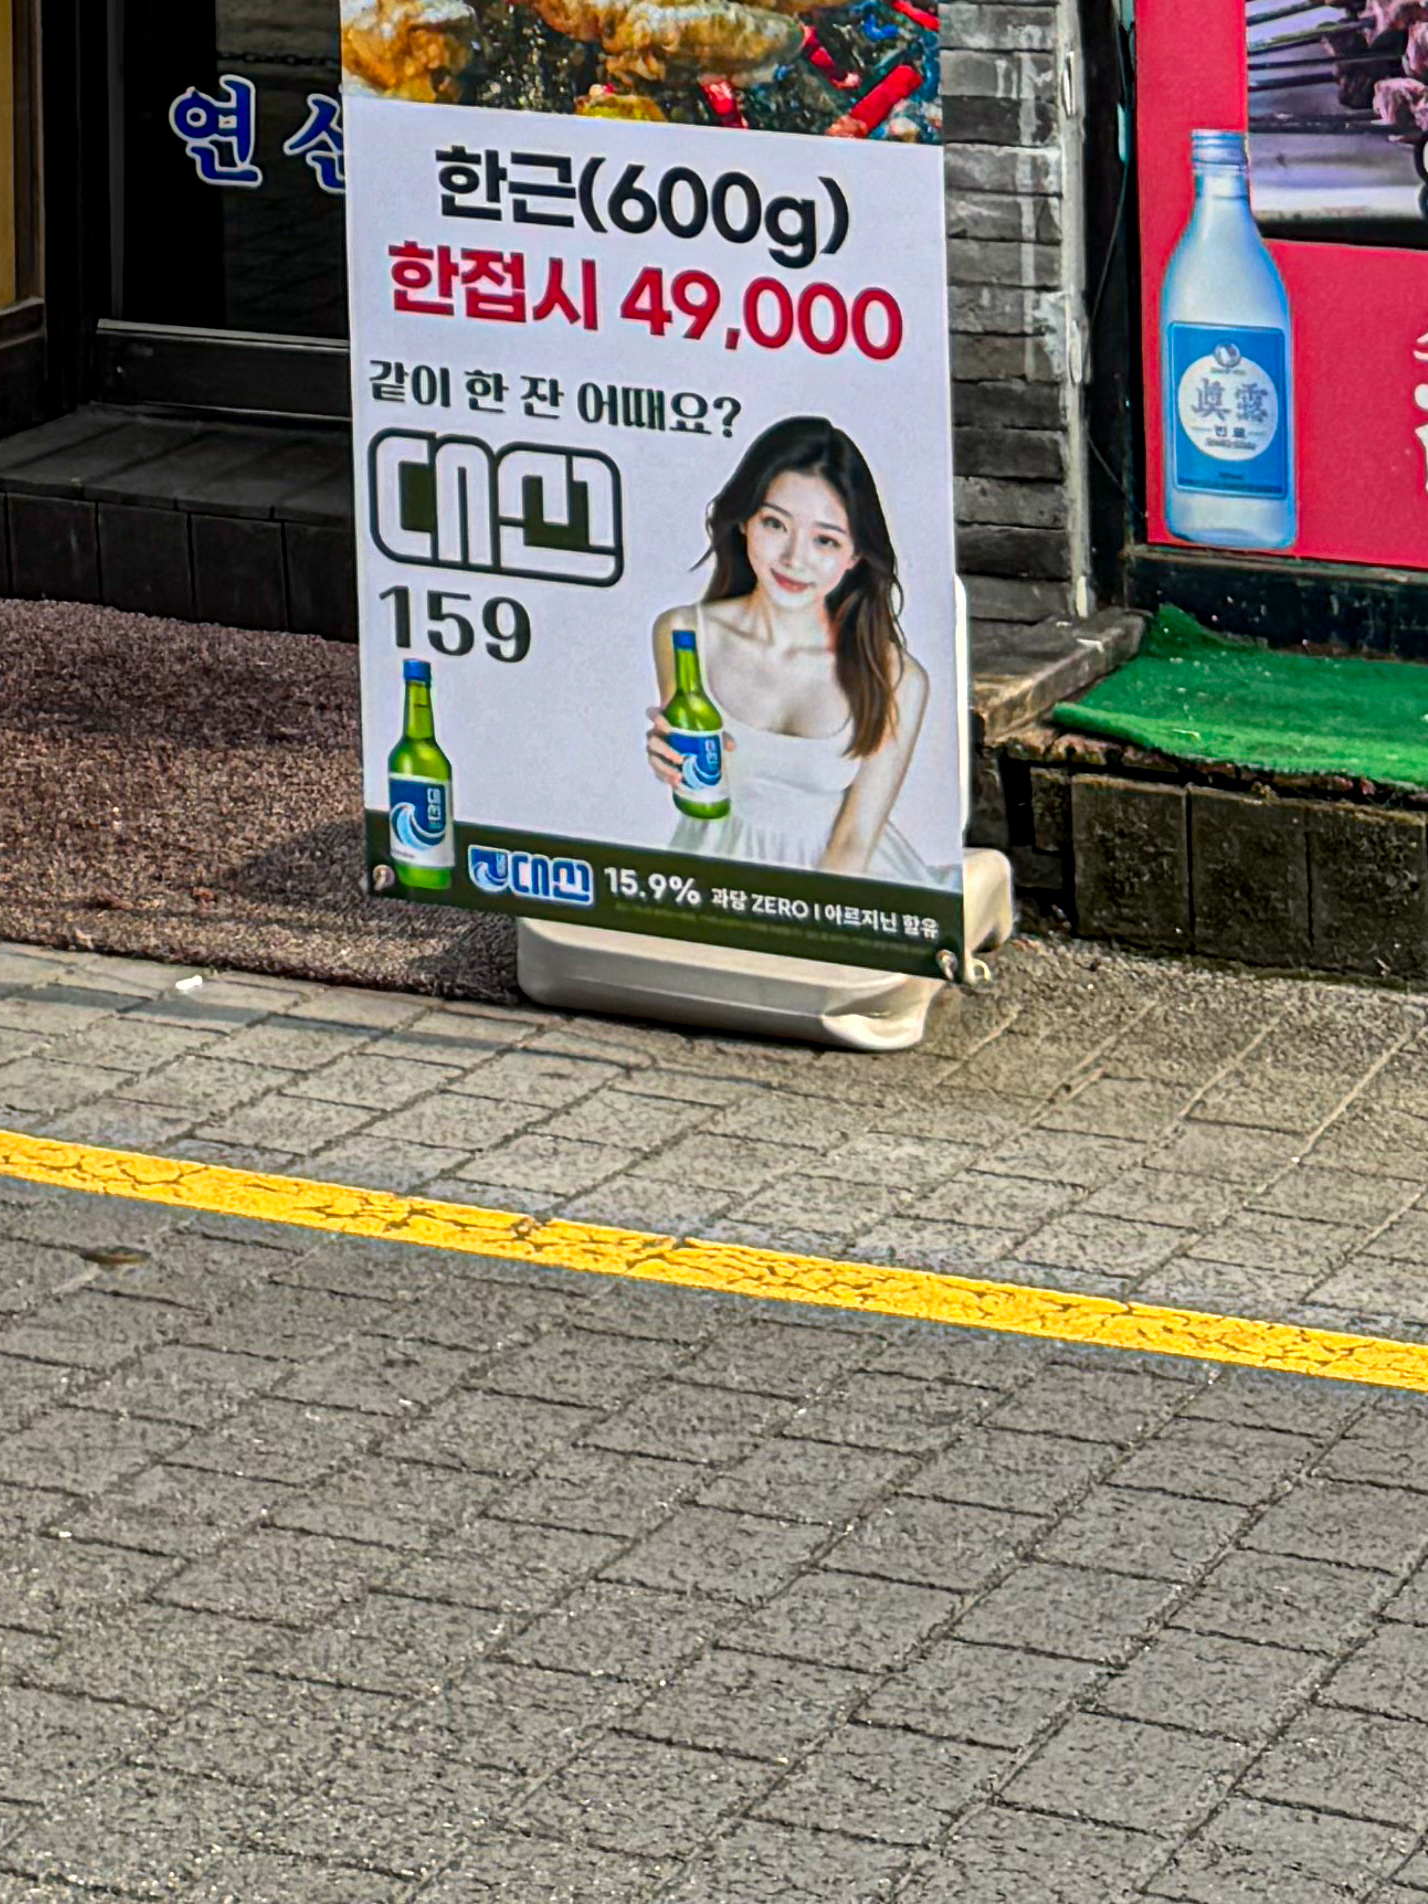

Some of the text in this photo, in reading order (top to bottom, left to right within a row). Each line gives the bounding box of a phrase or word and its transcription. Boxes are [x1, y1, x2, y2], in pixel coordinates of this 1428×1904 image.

[435, 145, 850, 269] 한근(600g)
[388, 240, 904, 361] 한접시 49,000
[368, 360, 743, 441] 같이 한 잔 어때요?
[379, 585, 532, 665] 159
[603, 865, 702, 906] 15.9%
[751, 892, 809, 920] ZERO
